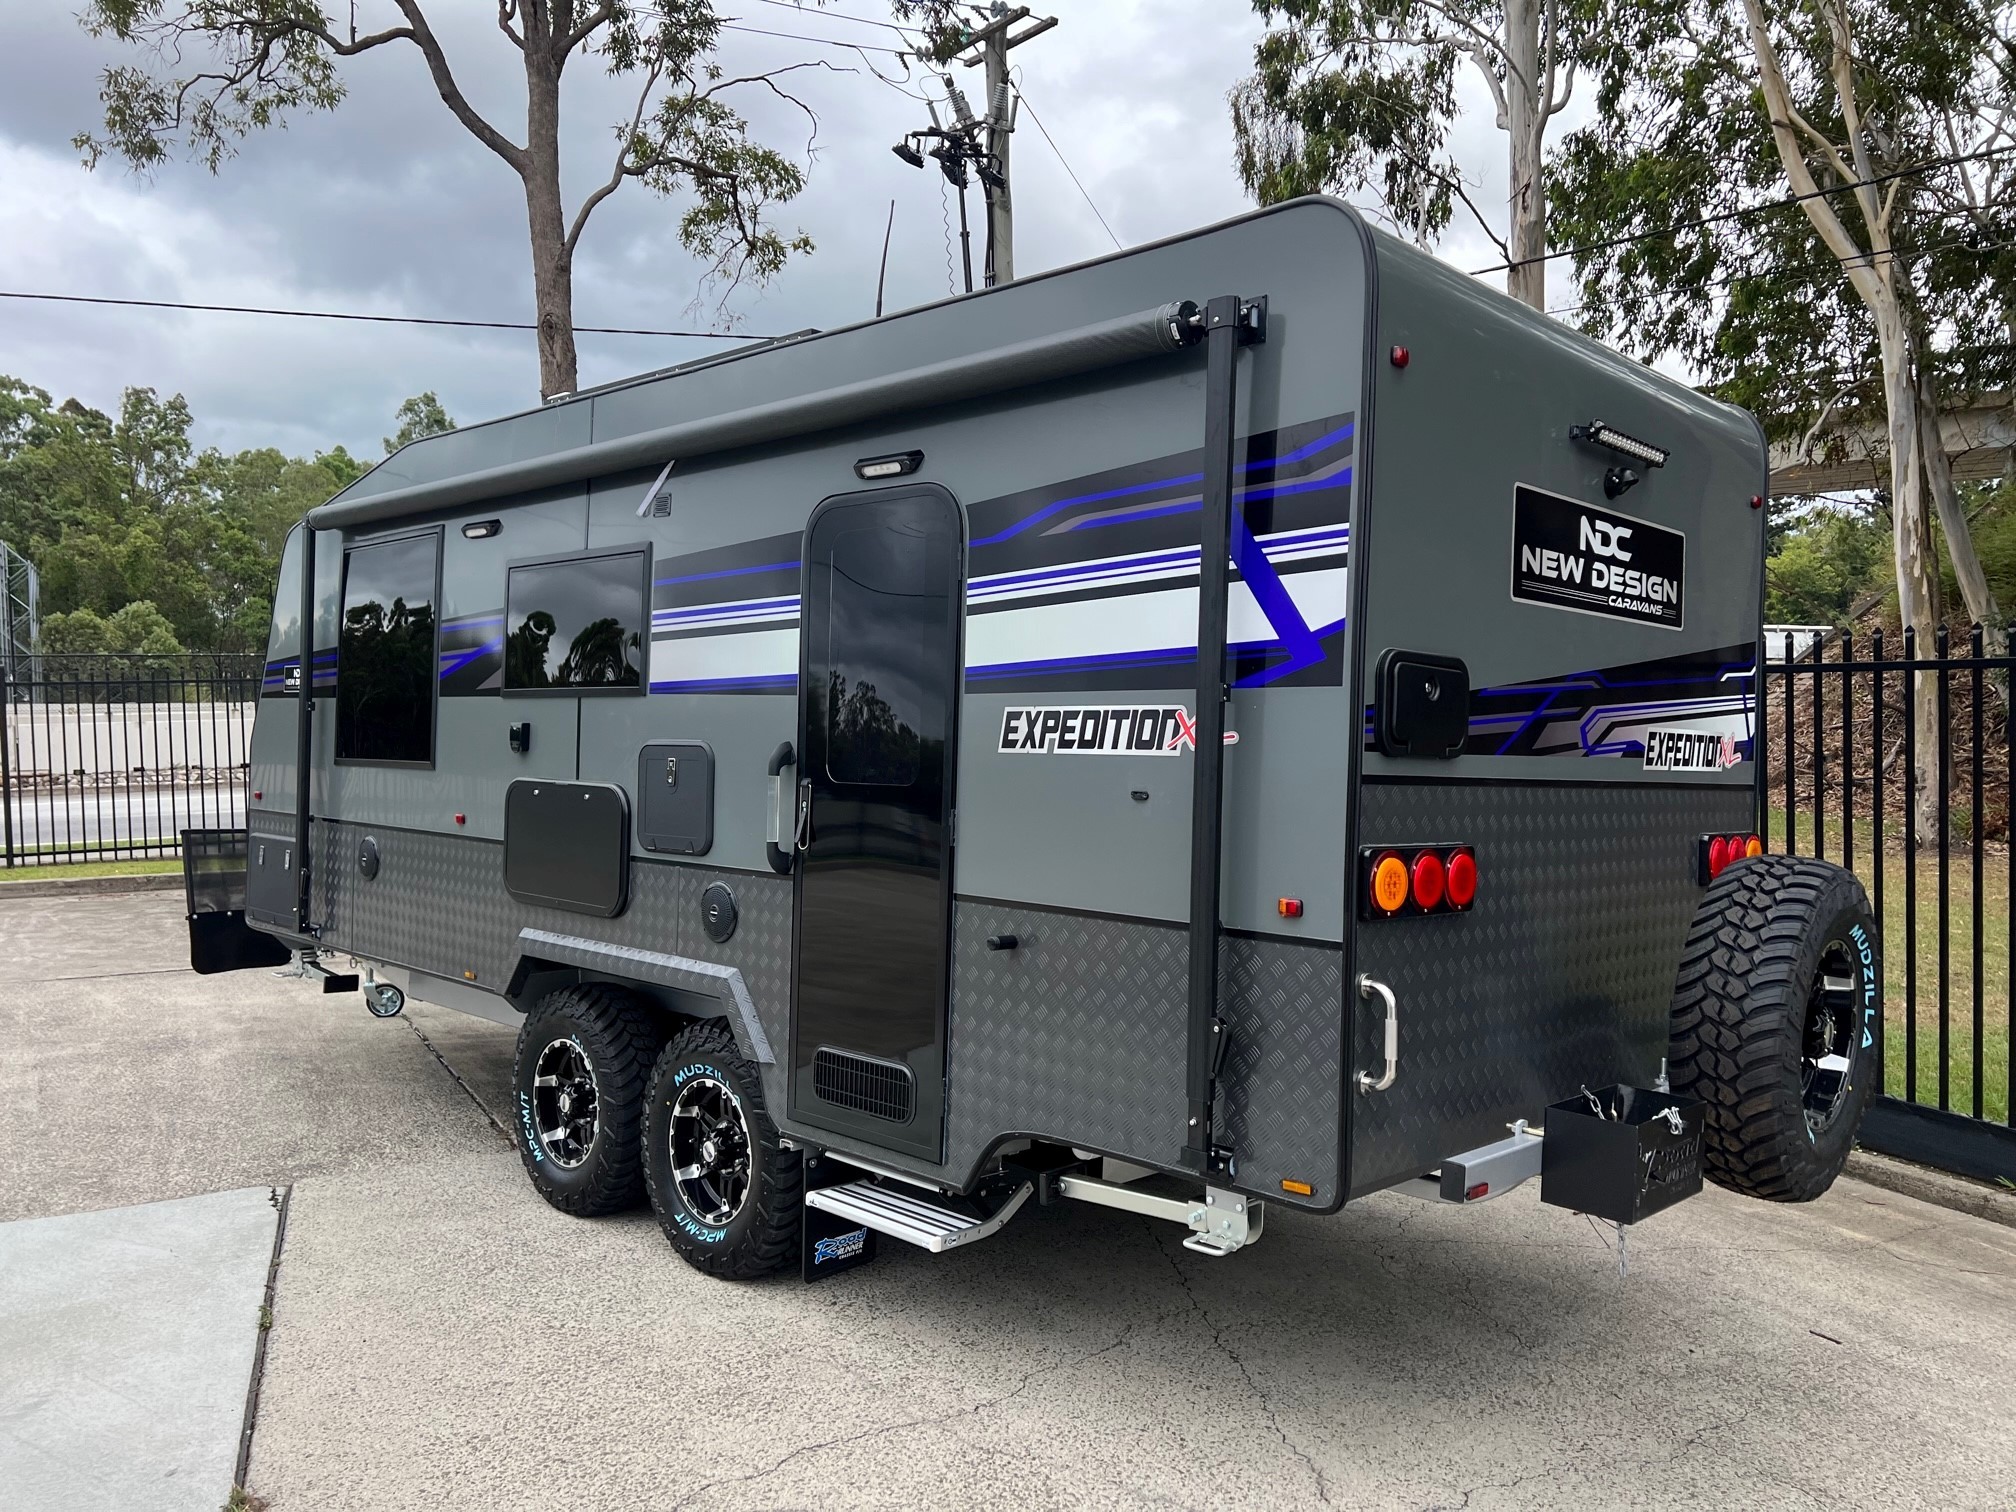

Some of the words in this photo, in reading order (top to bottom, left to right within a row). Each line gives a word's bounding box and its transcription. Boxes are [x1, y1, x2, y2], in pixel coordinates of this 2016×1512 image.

[1579, 515, 1633, 562] NDC
[1521, 544, 1585, 584] NEW
[1591, 561, 1678, 605] DESIGN
[1608, 595, 1663, 615] CARAVANS
[1001, 709, 1183, 751] EXPEDITION
[1645, 731, 1724, 768] EXPEDITION
[1848, 923, 1876, 1049] MUDZILLA
[837, 1241, 864, 1256] RUNNER
